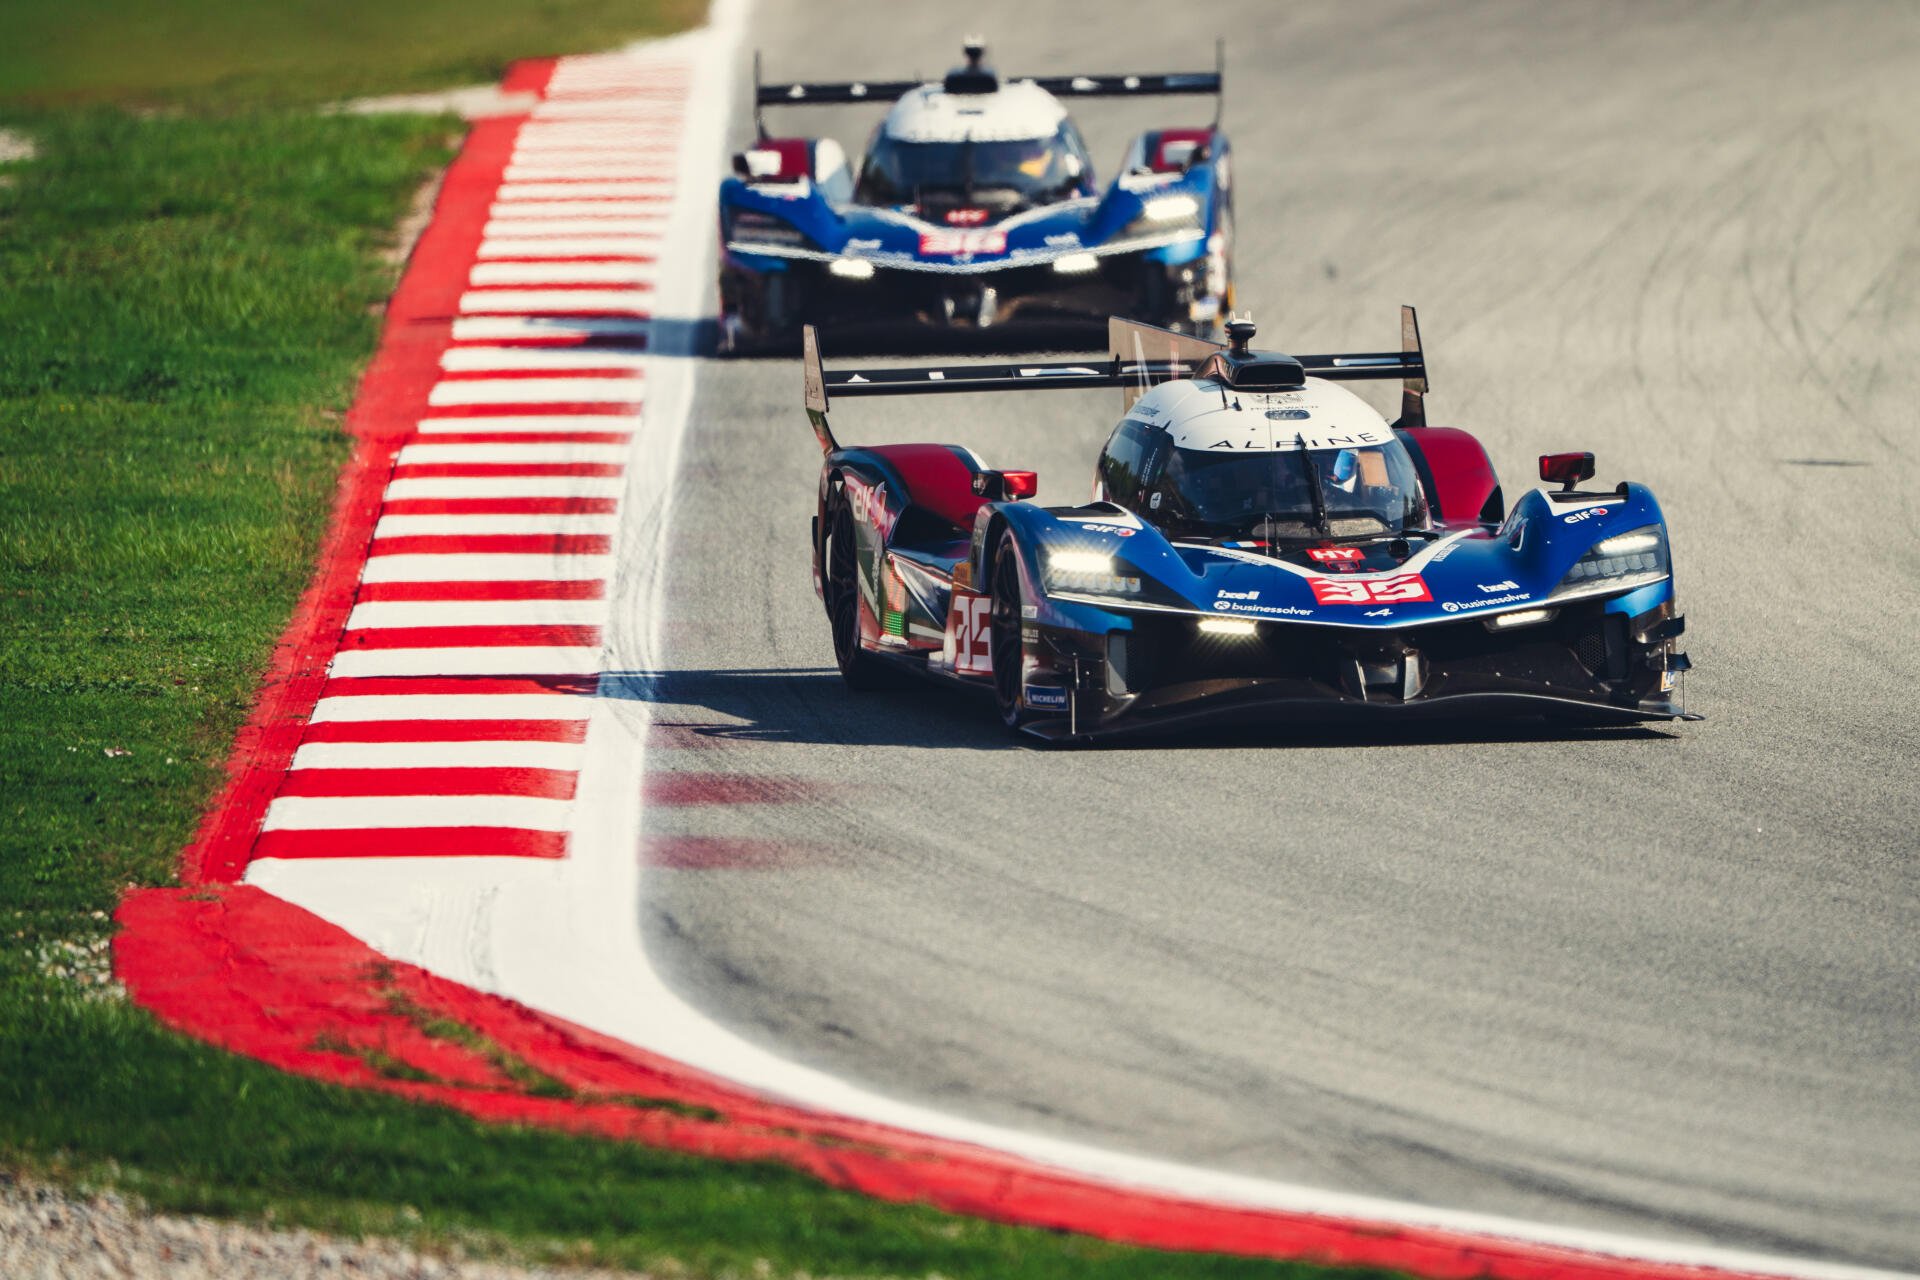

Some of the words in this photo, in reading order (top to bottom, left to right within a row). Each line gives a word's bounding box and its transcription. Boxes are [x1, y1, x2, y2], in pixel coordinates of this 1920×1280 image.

[1208, 432, 1379, 449] ALPINE
[853, 486, 874, 523] elf
[1564, 511, 1591, 524] elf
[1081, 524, 1117, 534] elf
[1312, 549, 1356, 560] HY
[1312, 575, 1425, 602] 35
[1459, 592, 1531, 610] businessolver
[1231, 602, 1314, 616] businessolver
[1031, 694, 1066, 704] MICHELIN
